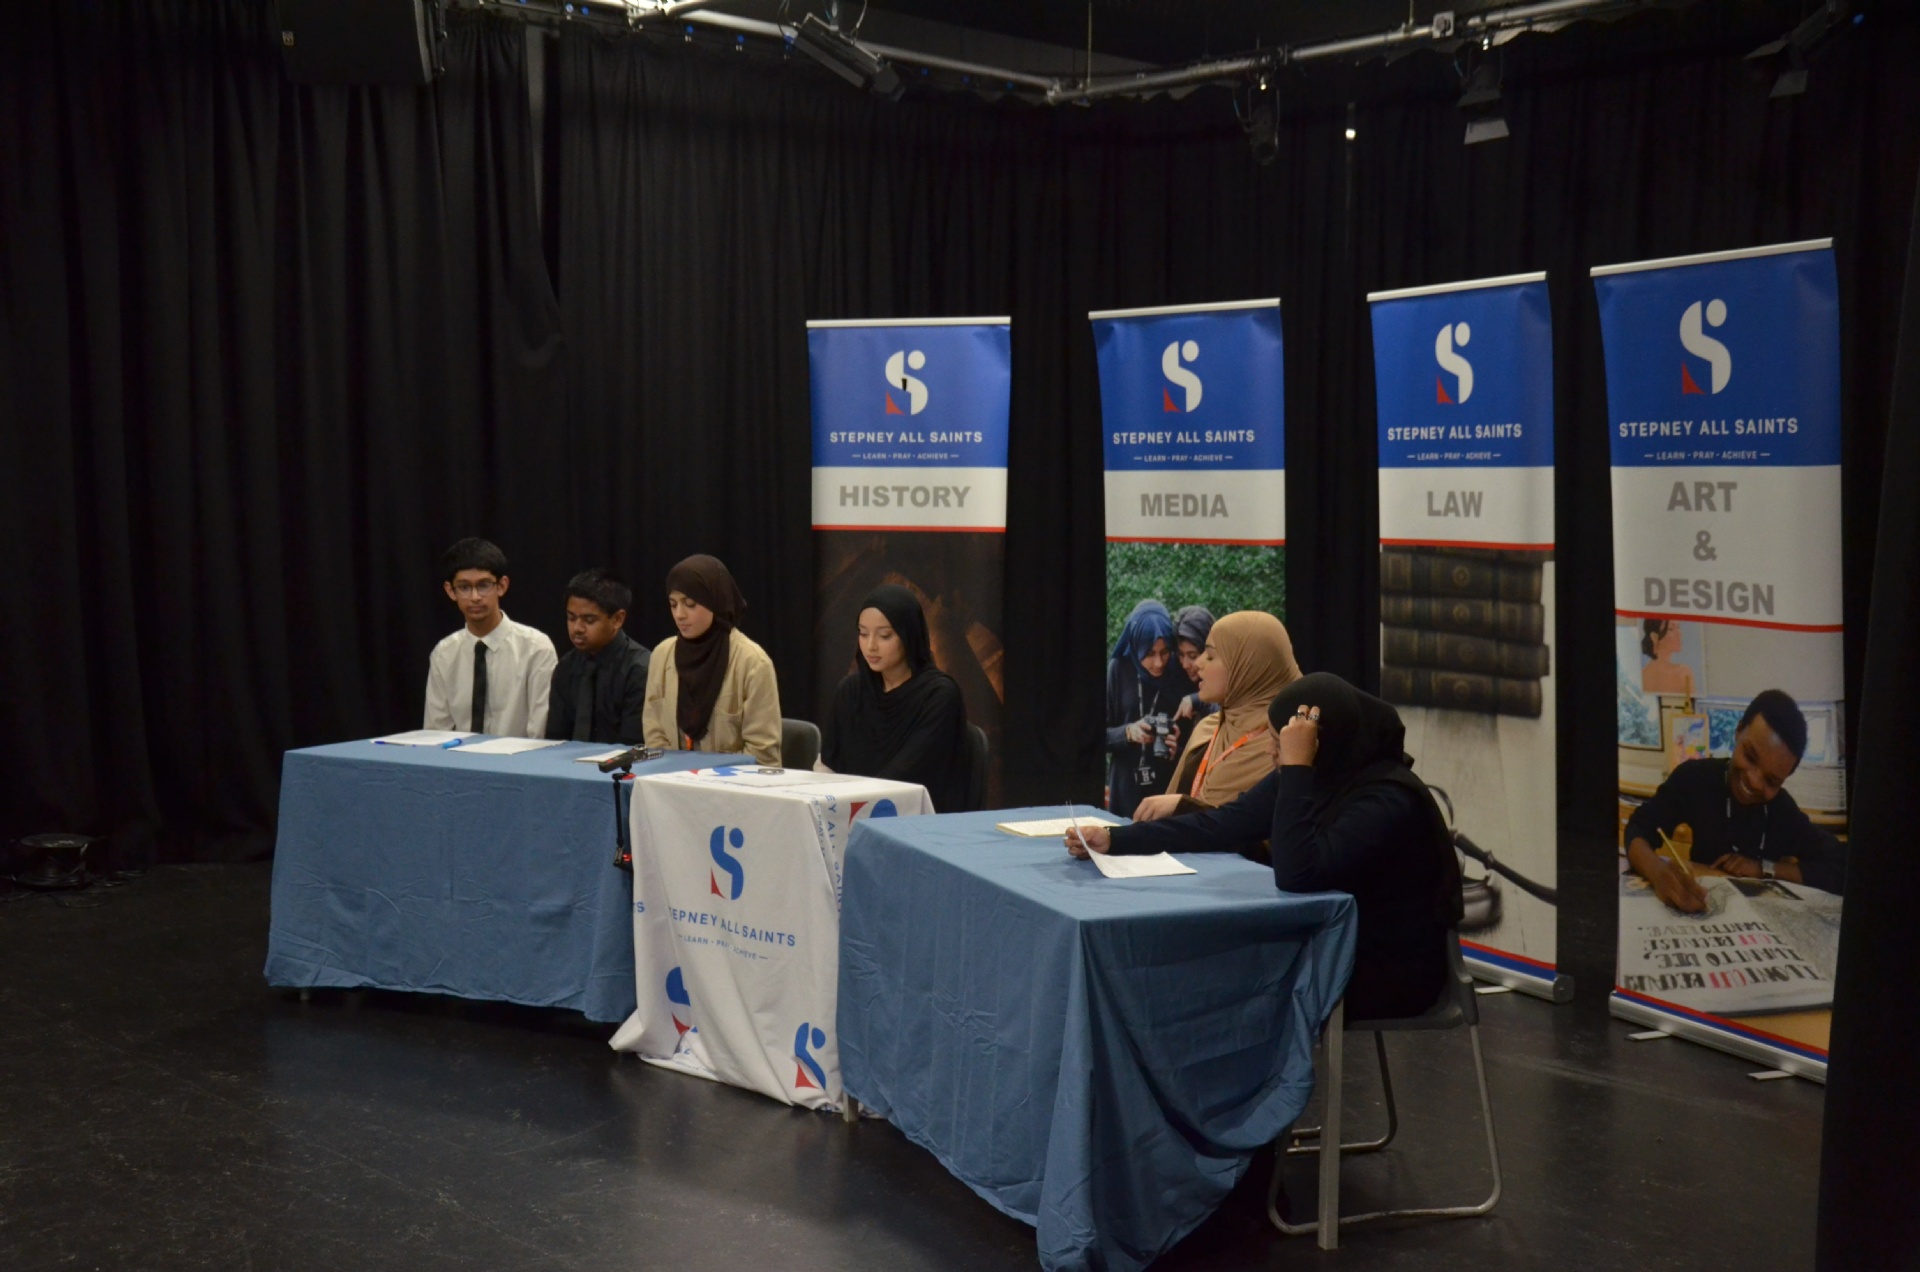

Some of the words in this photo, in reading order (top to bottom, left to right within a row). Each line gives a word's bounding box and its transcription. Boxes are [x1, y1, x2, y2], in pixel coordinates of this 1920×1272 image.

[830, 431, 894, 443] STEPNEY
[899, 431, 925, 443] ALL
[930, 431, 983, 443] SAINTS
[1113, 431, 1172, 445] STEPNEY
[1176, 430, 1200, 444] ALL
[1205, 429, 1255, 443] SAINTS
[1387, 426, 1445, 441] STEPNEY
[1449, 425, 1473, 440] ALL
[1475, 423, 1523, 439] SAINTS
[1619, 421, 1694, 437] STEPNEY
[1699, 419, 1730, 436] ALL
[1735, 417, 1799, 434] SAINTS
[1417, 452, 1439, 461] LEARN
[1443, 452, 1461, 460] PRAY
[1465, 452, 1491, 460] ACHIEVE
[1656, 451, 1685, 460] LEARN
[1692, 451, 1714, 460] PRAY
[1721, 450, 1757, 459] ACHIEVE
[839, 485, 971, 508] HISTORY
[1140, 494, 1229, 518] MEDIA
[1426, 491, 1484, 518] LAW
[1667, 481, 1737, 512] ART
[1692, 530, 1717, 561] &
[1644, 577, 1774, 616] DESIGN
[684, 934, 708, 945] LEARN
[721, 918, 740, 935] ALL
[742, 925, 796, 947] SAINTS
